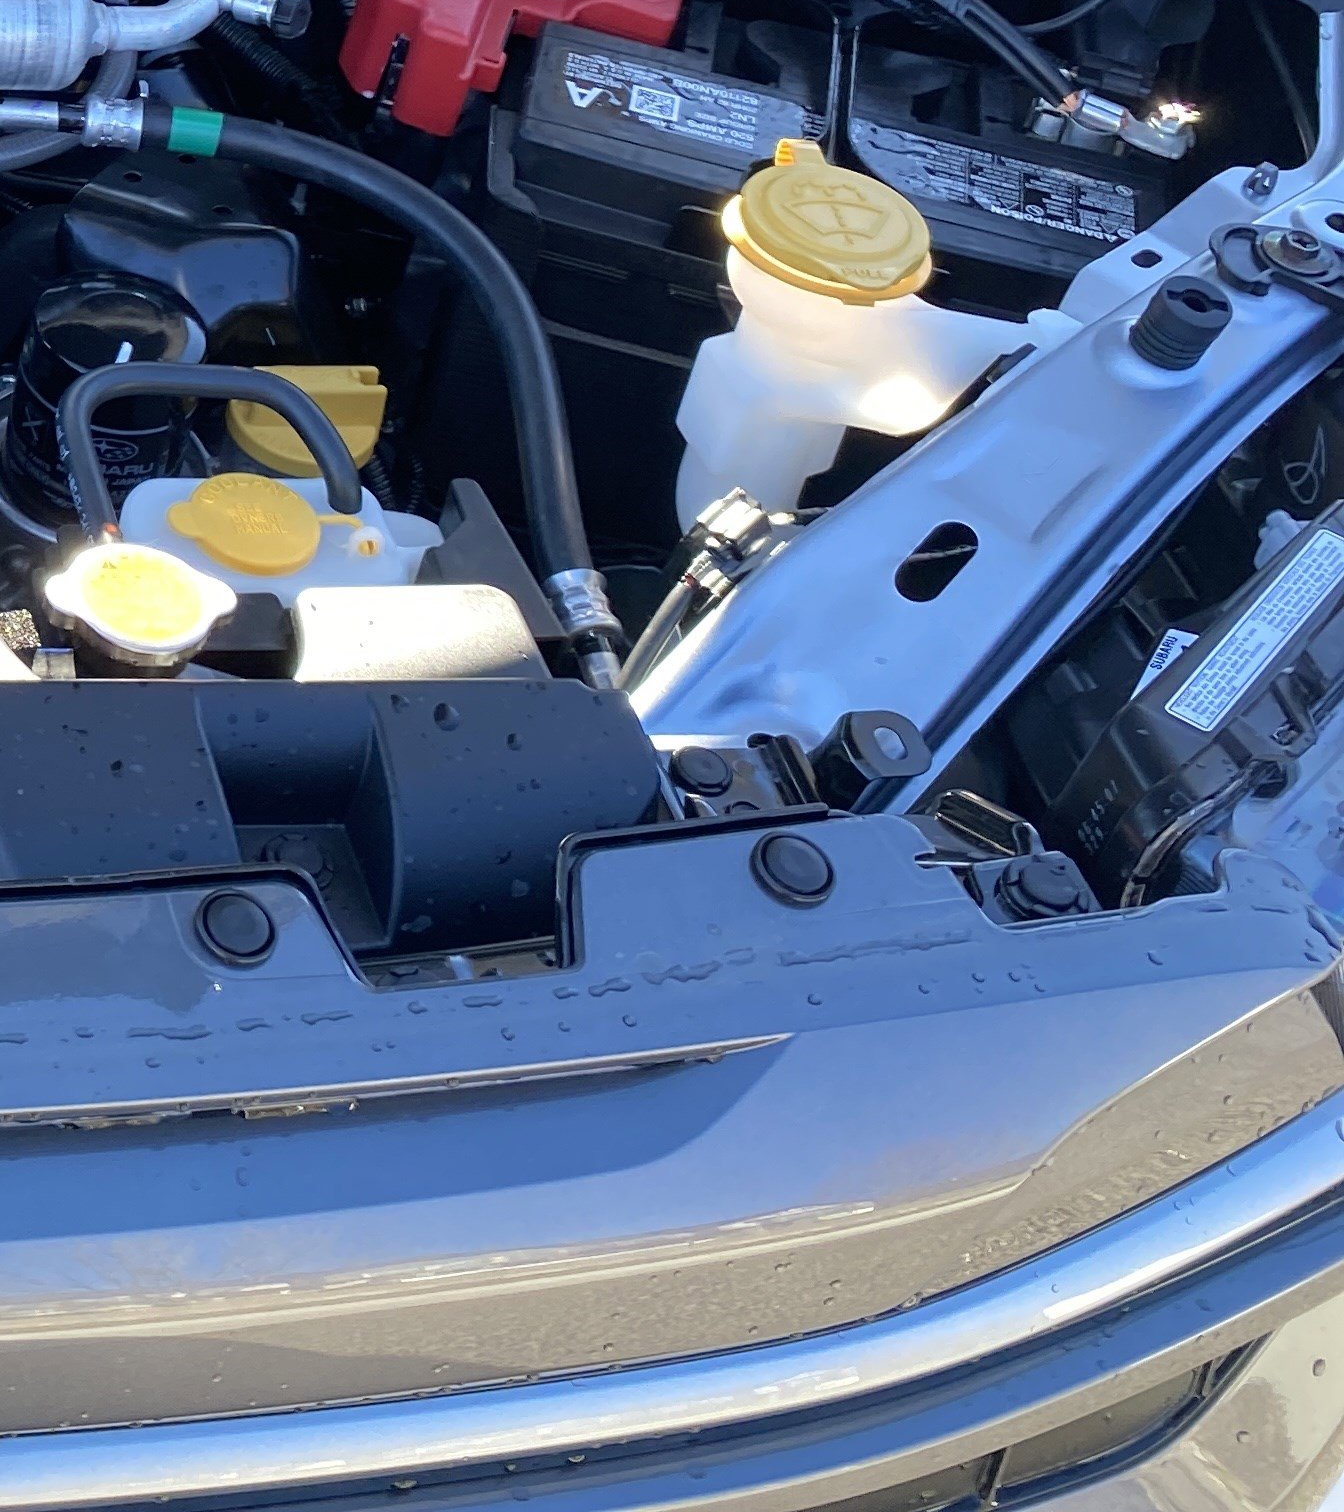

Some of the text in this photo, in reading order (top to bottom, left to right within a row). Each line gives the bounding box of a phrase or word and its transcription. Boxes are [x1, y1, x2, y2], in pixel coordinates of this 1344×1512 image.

[728, 111, 757, 124] LN2
[686, 119, 726, 137] AMPS
[199, 477, 299, 504] COOLANT
[236, 523, 289, 535] MANUAL
[1149, 635, 1179, 670] SUBARU
